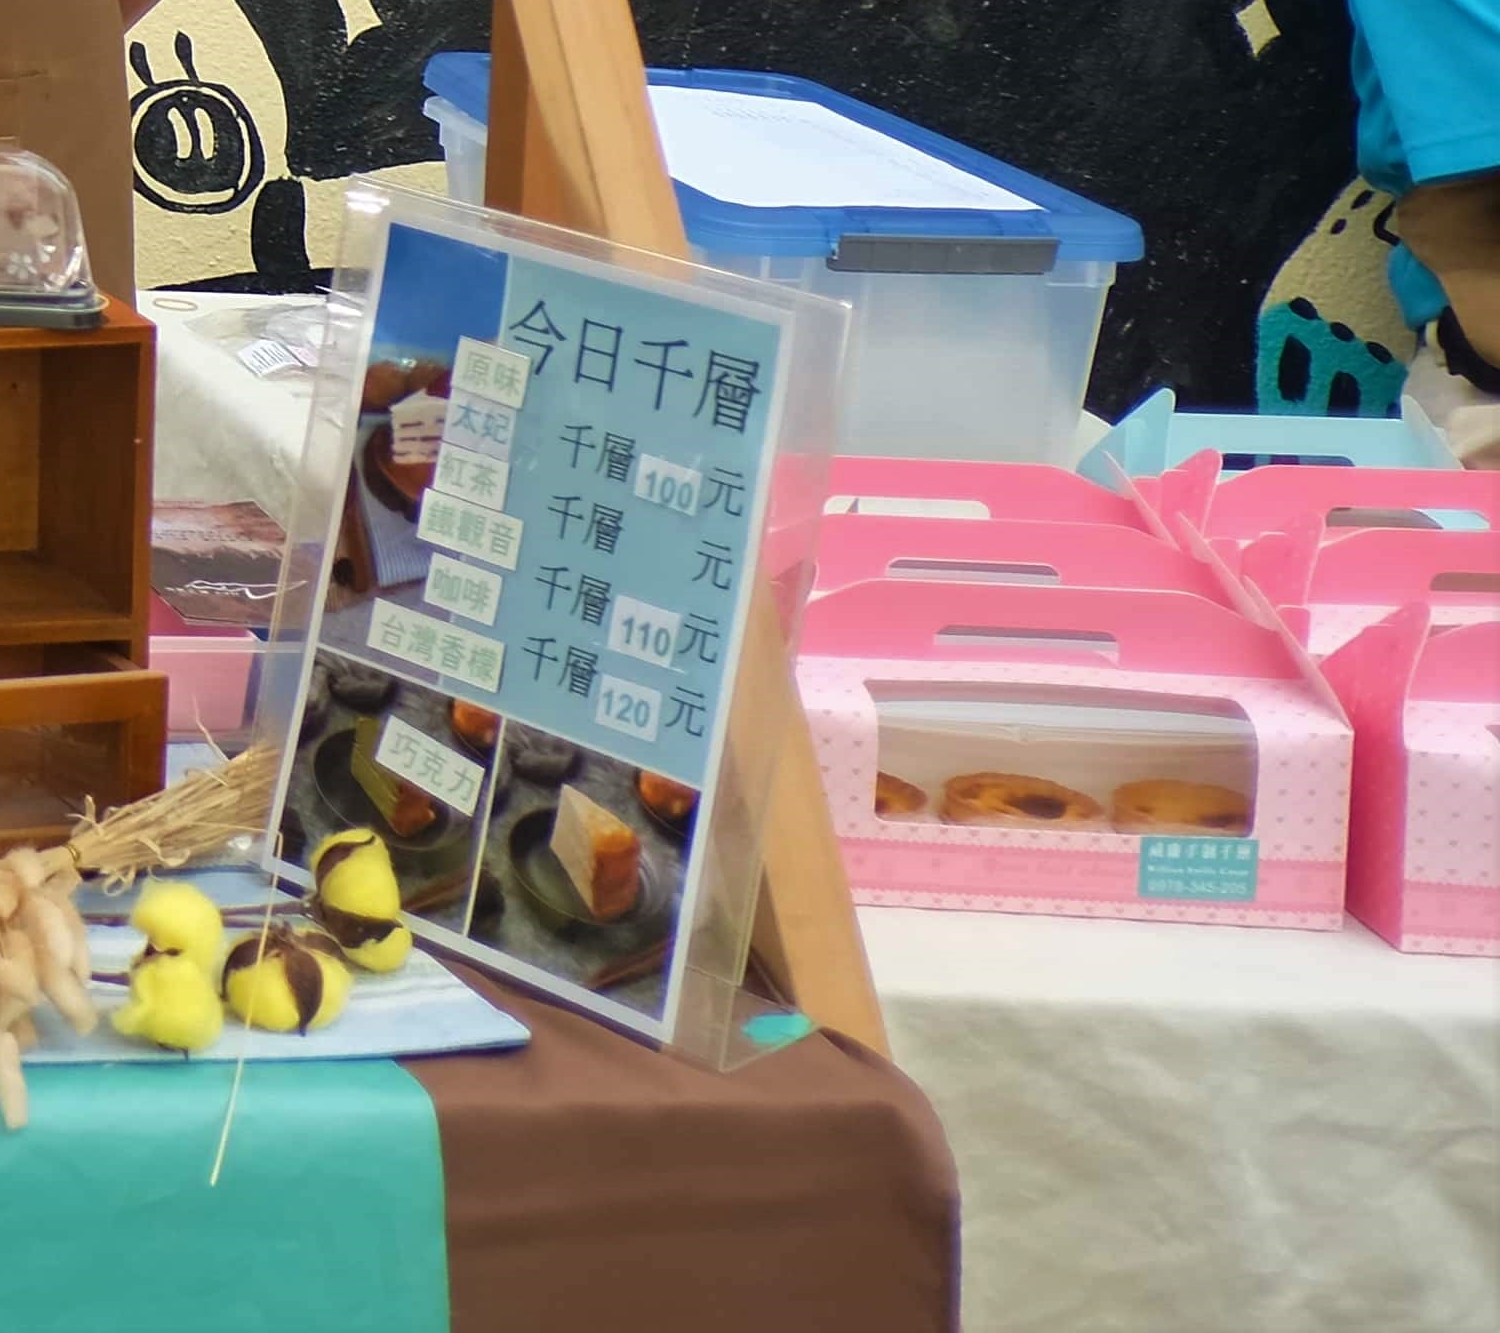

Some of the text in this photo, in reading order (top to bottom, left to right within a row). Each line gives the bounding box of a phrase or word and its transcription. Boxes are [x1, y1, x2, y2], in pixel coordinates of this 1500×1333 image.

[460, 349, 521, 400] 原味
[508, 299, 762, 435] 今日千層
[438, 451, 500, 498] 紅茶
[558, 424, 745, 517] 千層 100 元
[431, 565, 494, 614] 咖啡
[547, 495, 734, 591] 千層 元
[534, 565, 721, 664] 千層 110 元
[521, 636, 707, 738] 千層 120 元
[391, 732, 479, 805] 巧克力
